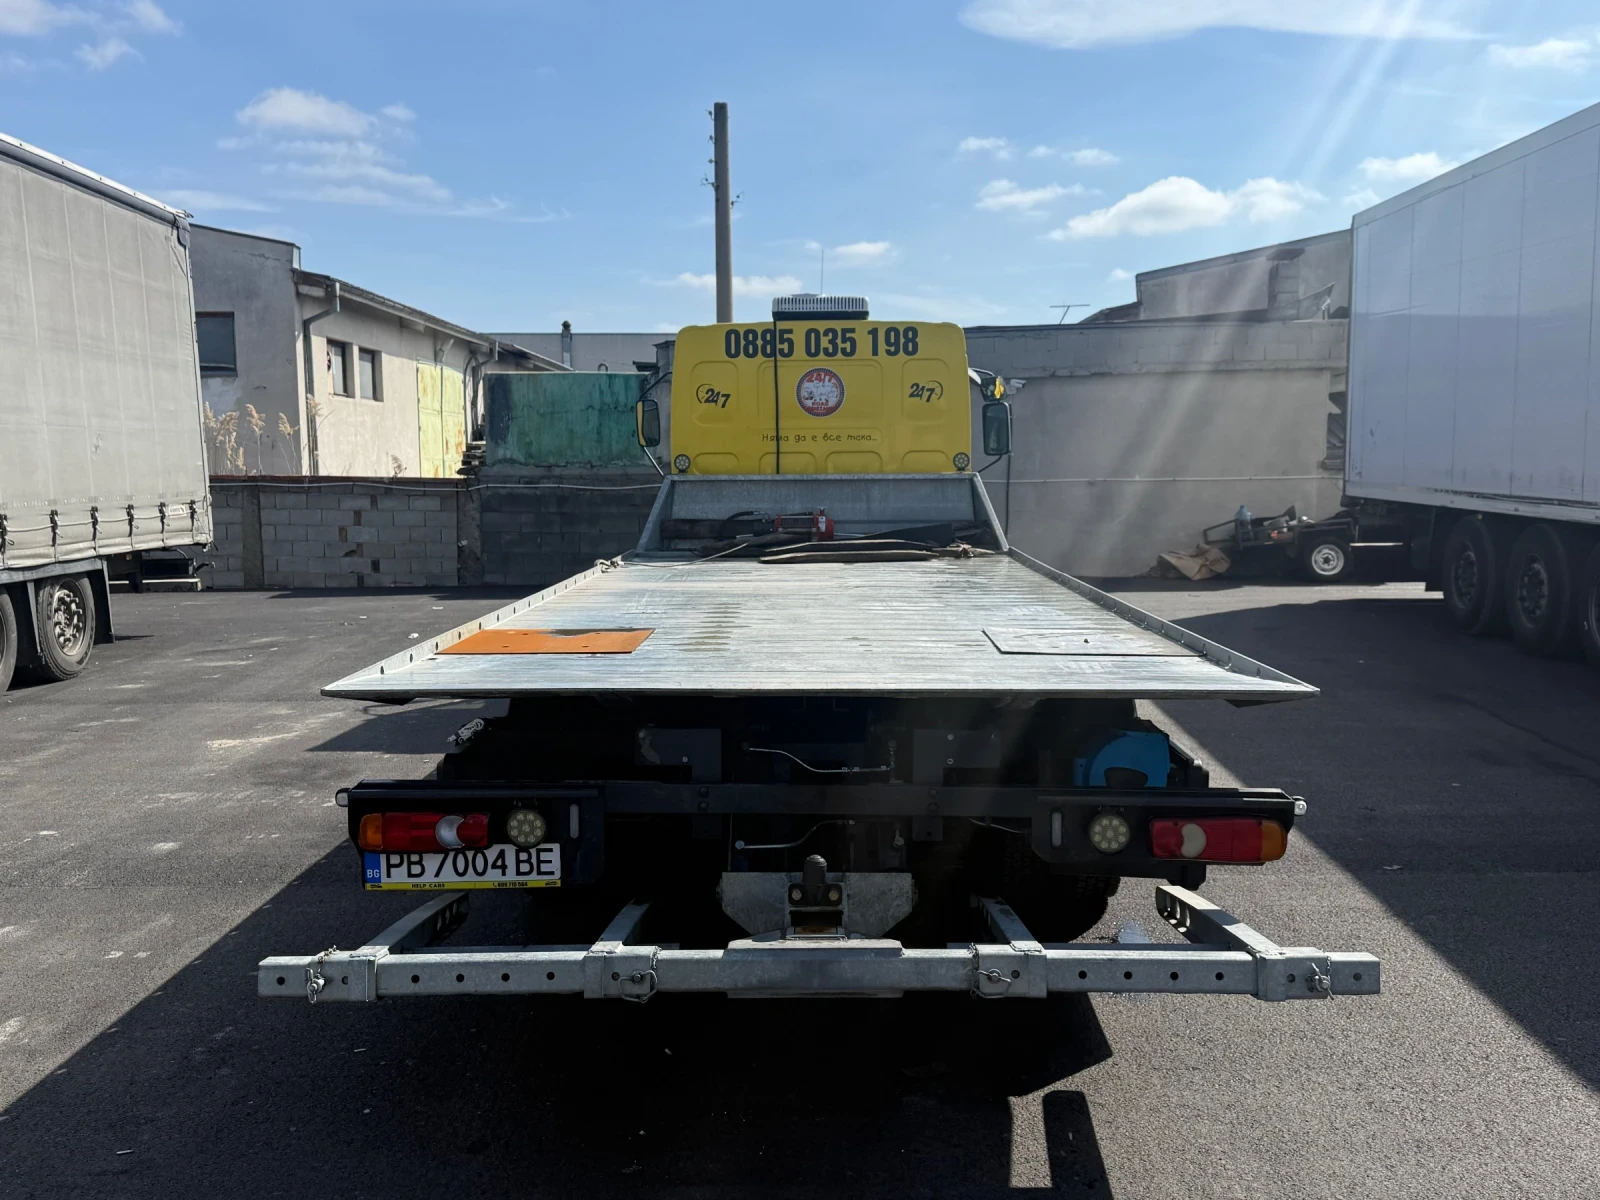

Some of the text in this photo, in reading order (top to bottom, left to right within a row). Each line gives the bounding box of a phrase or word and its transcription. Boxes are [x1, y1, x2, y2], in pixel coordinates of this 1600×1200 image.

[725, 326, 918, 358] 0885 035 198
[367, 869, 380, 878] BG
[515, 847, 555, 876] BE
